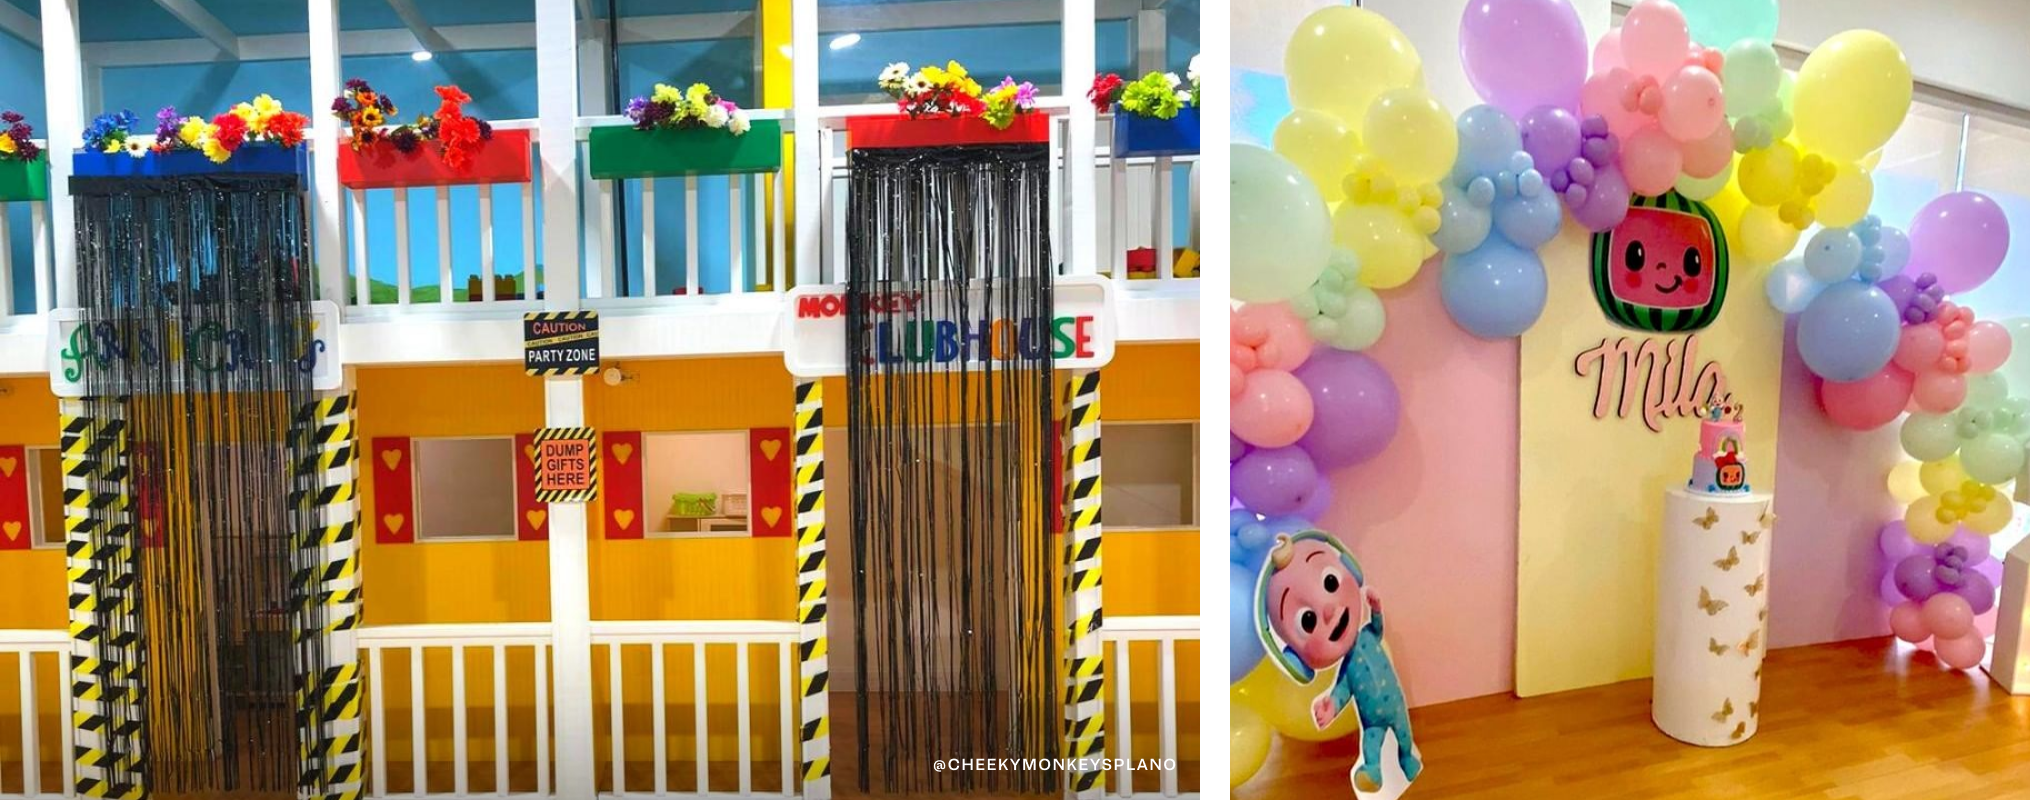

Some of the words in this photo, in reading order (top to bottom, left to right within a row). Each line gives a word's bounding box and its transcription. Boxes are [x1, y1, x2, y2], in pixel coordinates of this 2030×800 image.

[799, 291, 922, 317] MOKEY
[533, 322, 587, 335] CAUTION
[528, 349, 564, 362] PARTY
[566, 348, 596, 362] ZONE
[546, 444, 584, 457] DUMP
[546, 458, 584, 471] GIFTS
[546, 472, 584, 486] HERE
